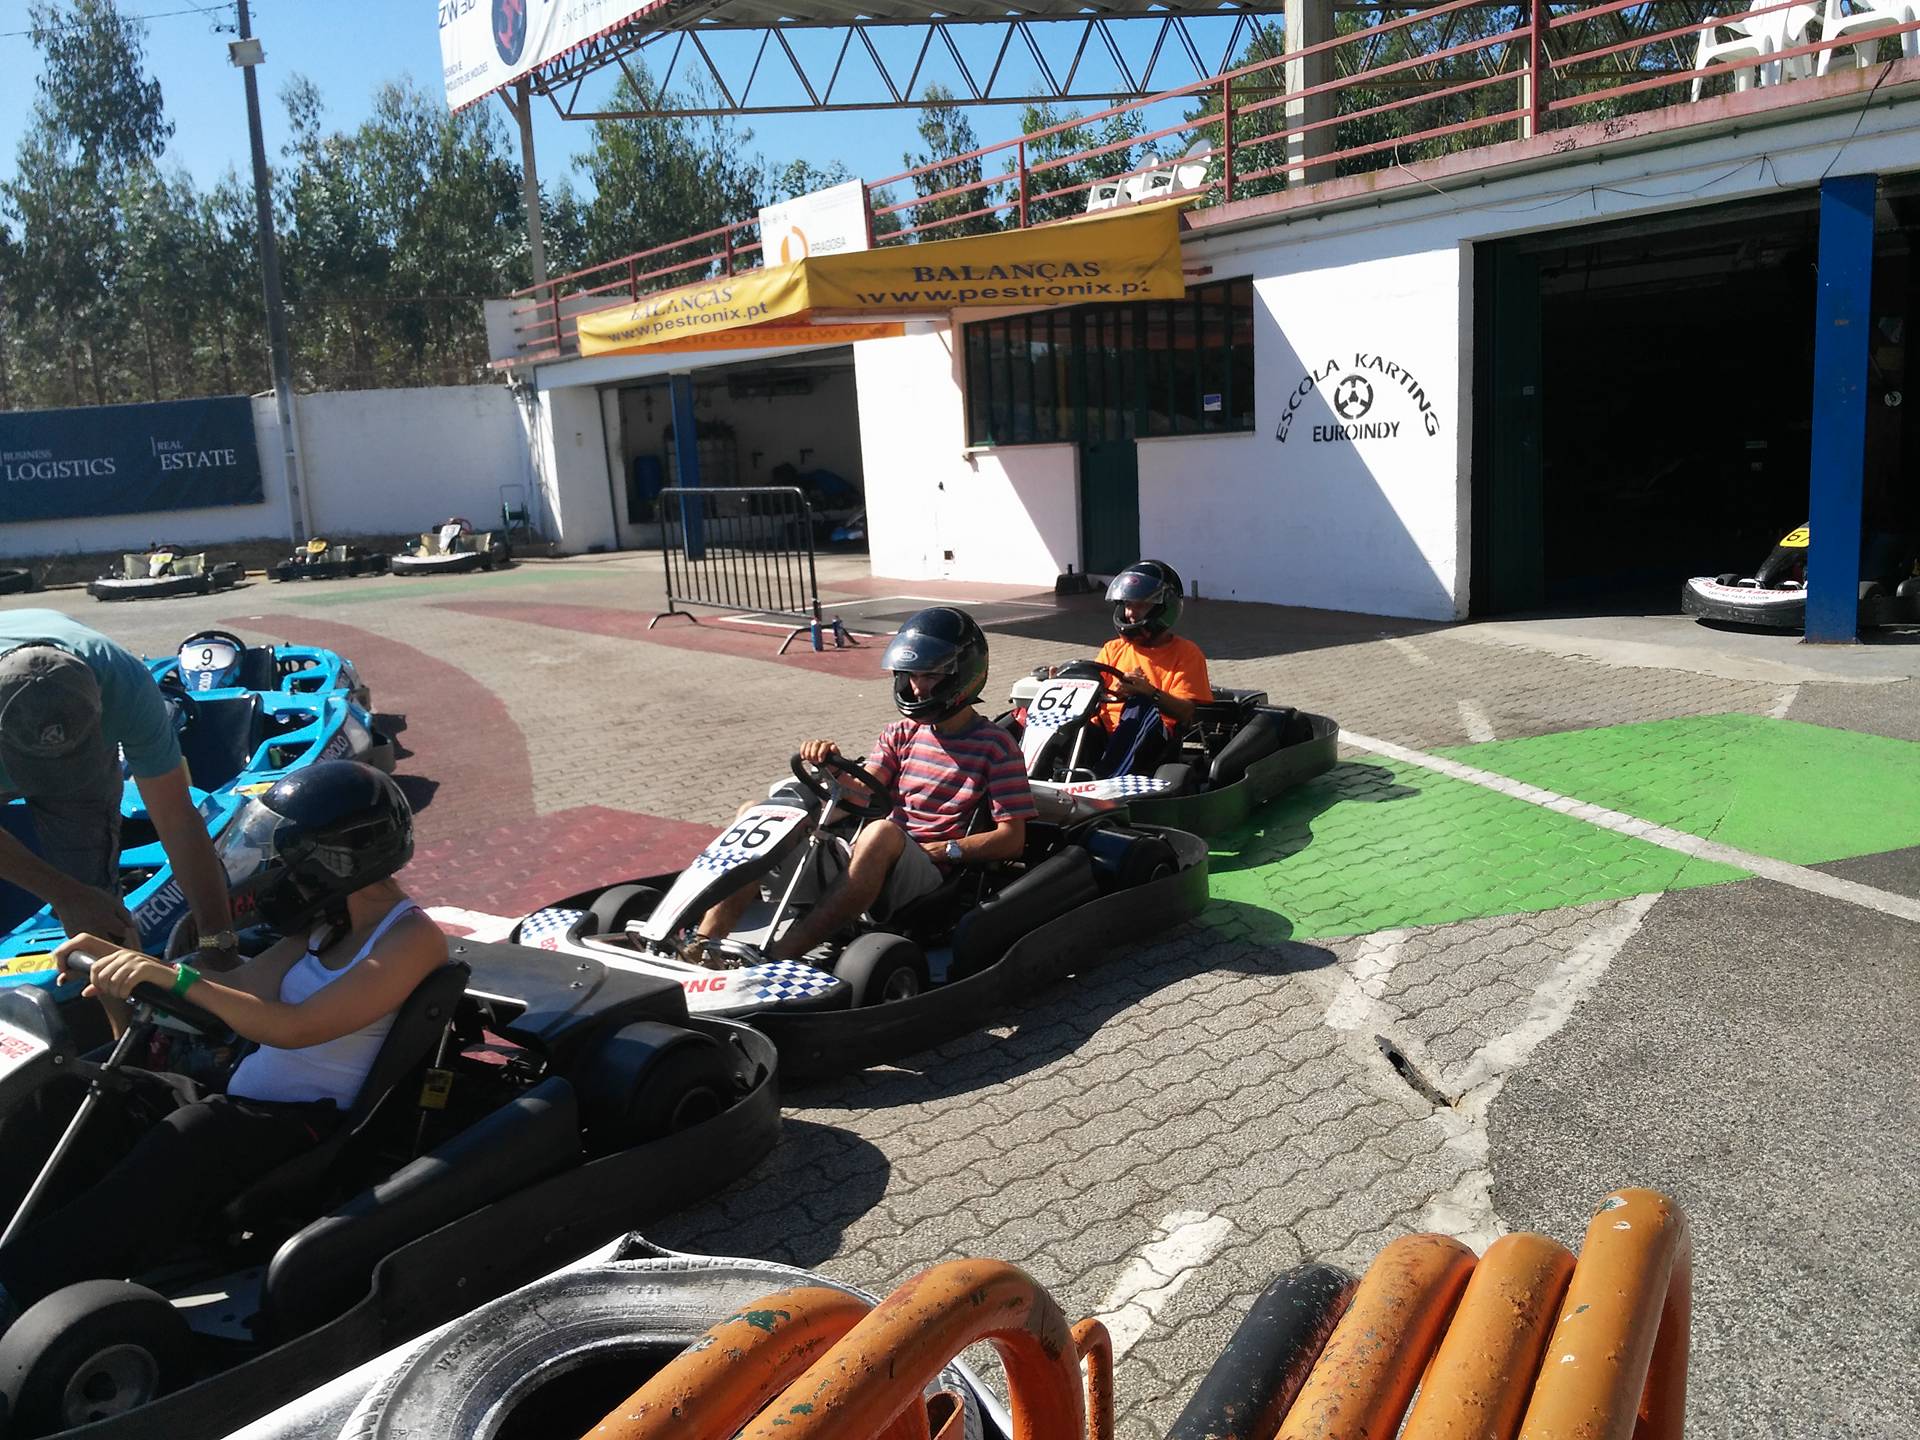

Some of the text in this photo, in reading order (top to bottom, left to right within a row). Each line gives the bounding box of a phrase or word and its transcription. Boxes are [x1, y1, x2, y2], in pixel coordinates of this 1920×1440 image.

[912, 261, 1101, 283] BALANÇAS
[607, 301, 769, 343] www.pestronix.pt
[1276, 353, 1440, 443] ESCOLA KARTING
[1313, 421, 1400, 442] EUROINDY
[157, 439, 183, 451] REAL
[6, 457, 117, 481] LOGISTICS
[160, 449, 237, 471] ESTATE
[201, 648, 213, 666] 9
[1037, 686, 1079, 716] 64
[719, 815, 787, 849] 66
